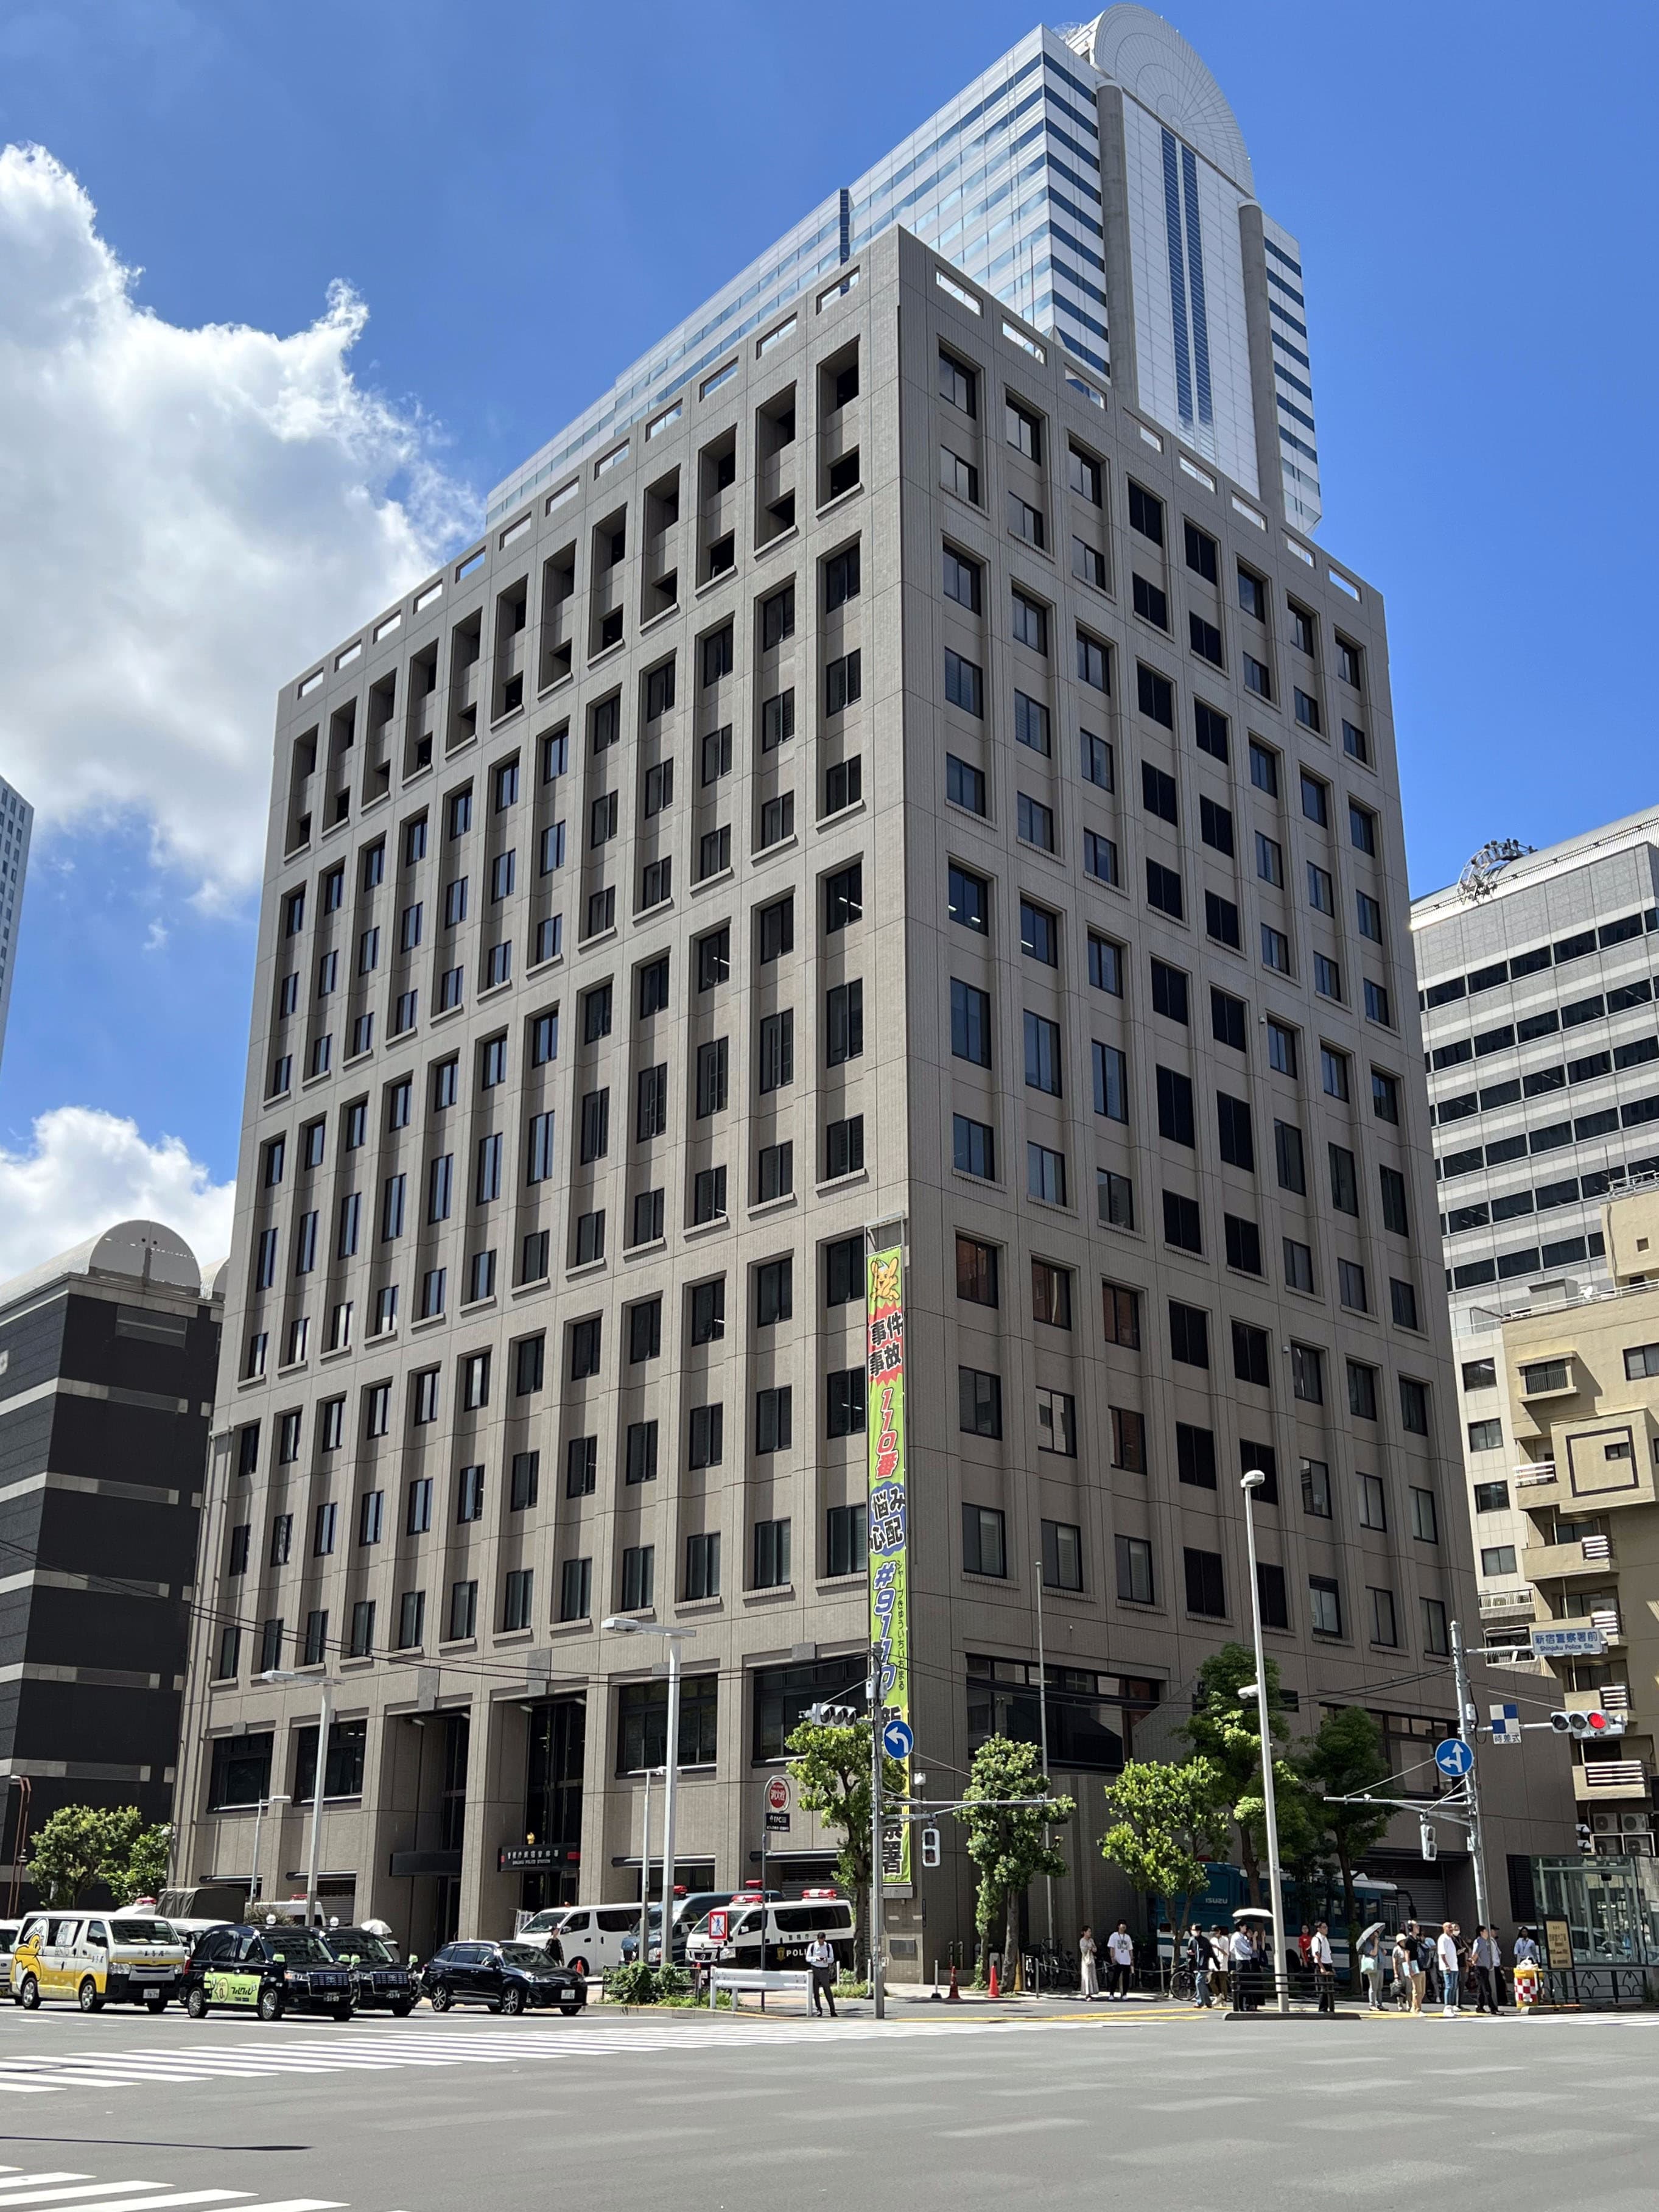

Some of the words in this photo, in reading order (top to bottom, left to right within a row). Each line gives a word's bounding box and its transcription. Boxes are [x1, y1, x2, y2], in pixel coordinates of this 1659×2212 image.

[871, 1311, 902, 1346] 事件
[869, 1342, 901, 1377] 事故
[876, 1388, 898, 1479] 110番
[873, 1488, 905, 1520] 悩み
[871, 1515, 903, 1551] 心配
[874, 1561, 896, 1691] #9110
[1535, 1631, 1598, 1644] 新宿警察署前
[1495, 1733, 1520, 1743] 時差式
[786, 1948, 807, 1957] POLI
